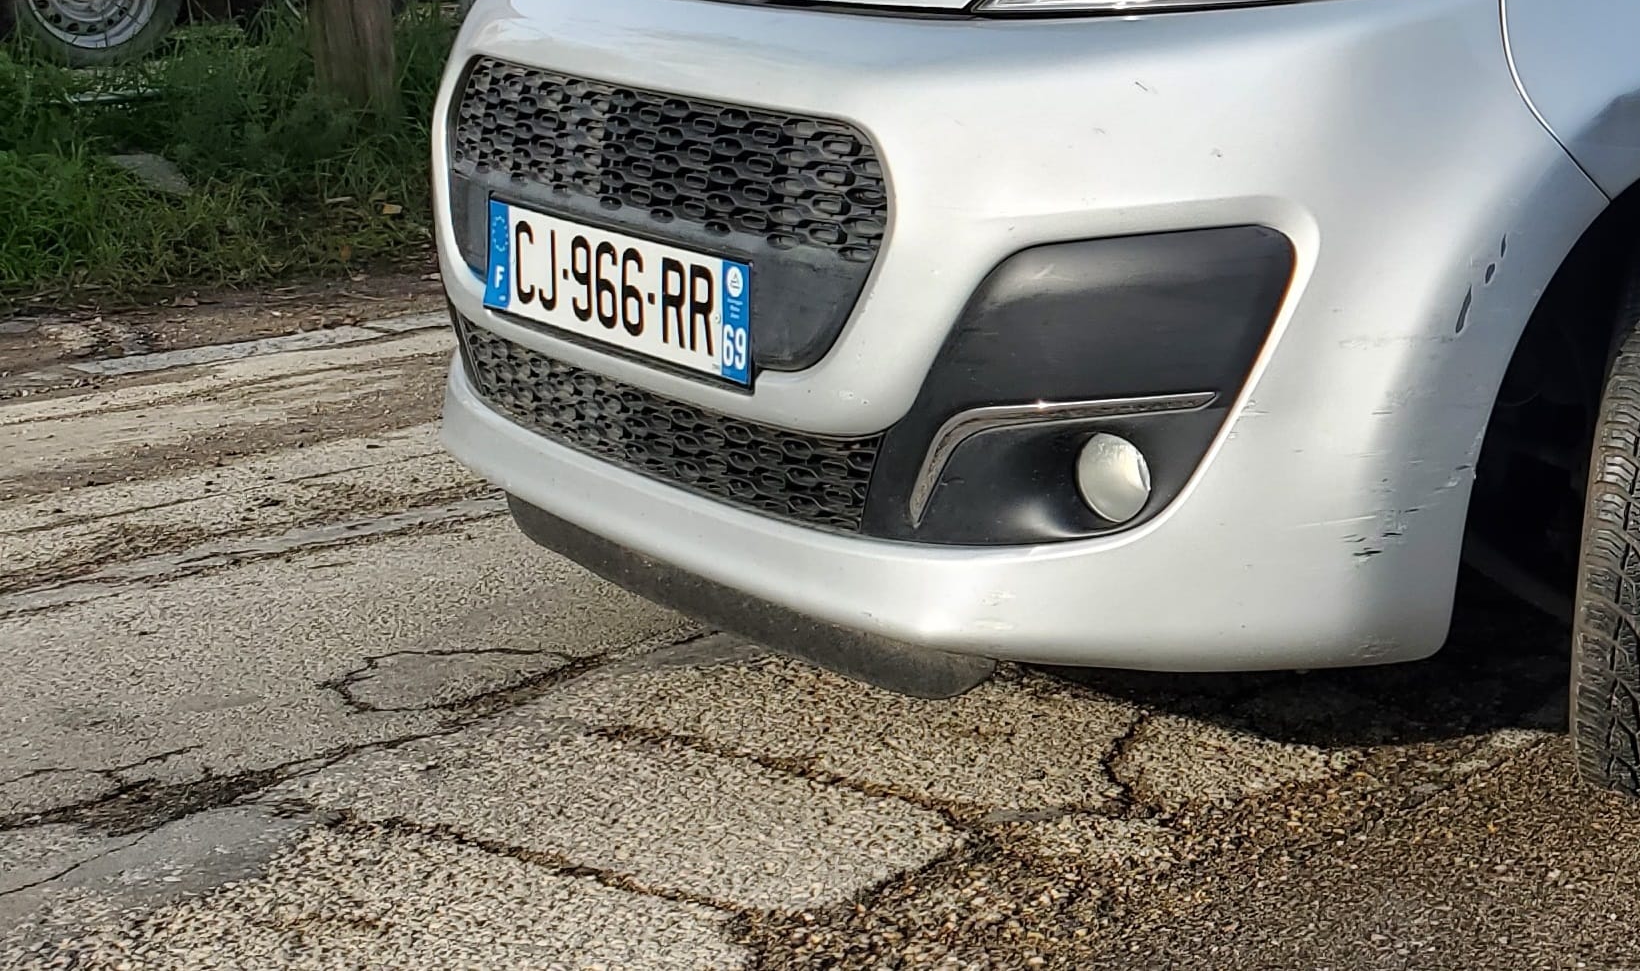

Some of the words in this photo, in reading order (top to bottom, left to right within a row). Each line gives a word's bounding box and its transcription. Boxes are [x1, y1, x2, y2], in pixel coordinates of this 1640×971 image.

[494, 264, 506, 289] F
[514, 219, 715, 358] CJ-966-RR
[722, 323, 747, 371] 69
